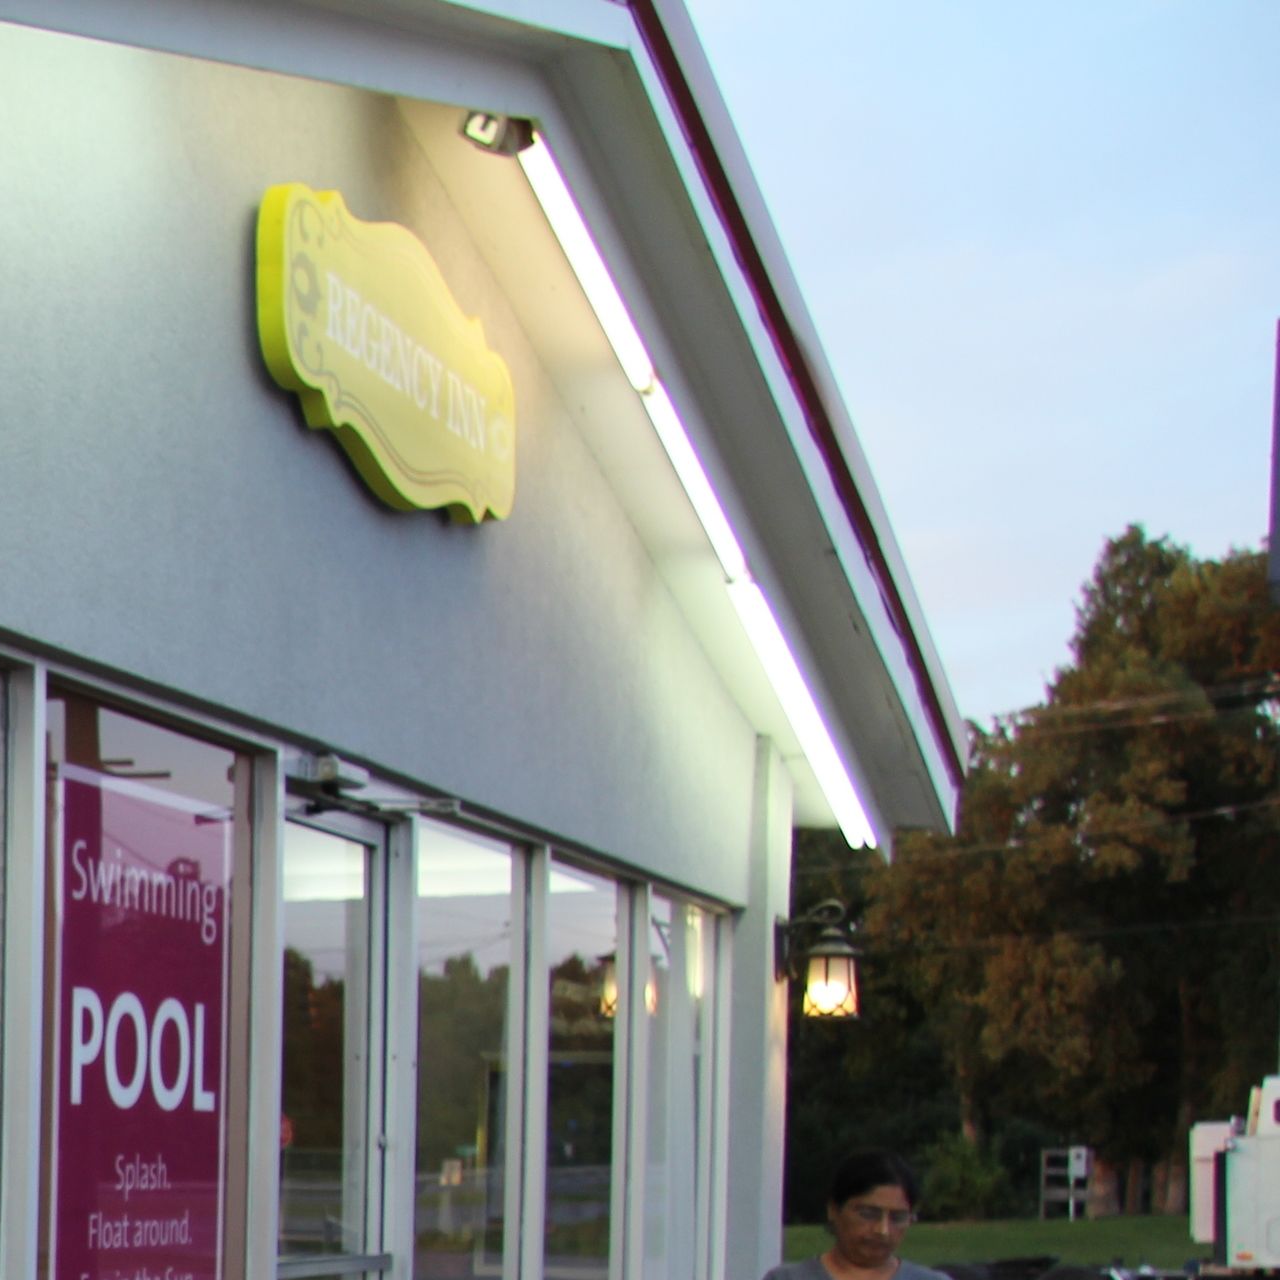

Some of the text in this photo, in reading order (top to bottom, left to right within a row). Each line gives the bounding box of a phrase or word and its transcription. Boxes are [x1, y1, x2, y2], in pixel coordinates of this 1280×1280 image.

[71, 839, 218, 945] Swimming
[70, 986, 216, 1112] POOL
[114, 1153, 172, 1201] Splash.
[88, 1208, 192, 1249] Float around.
